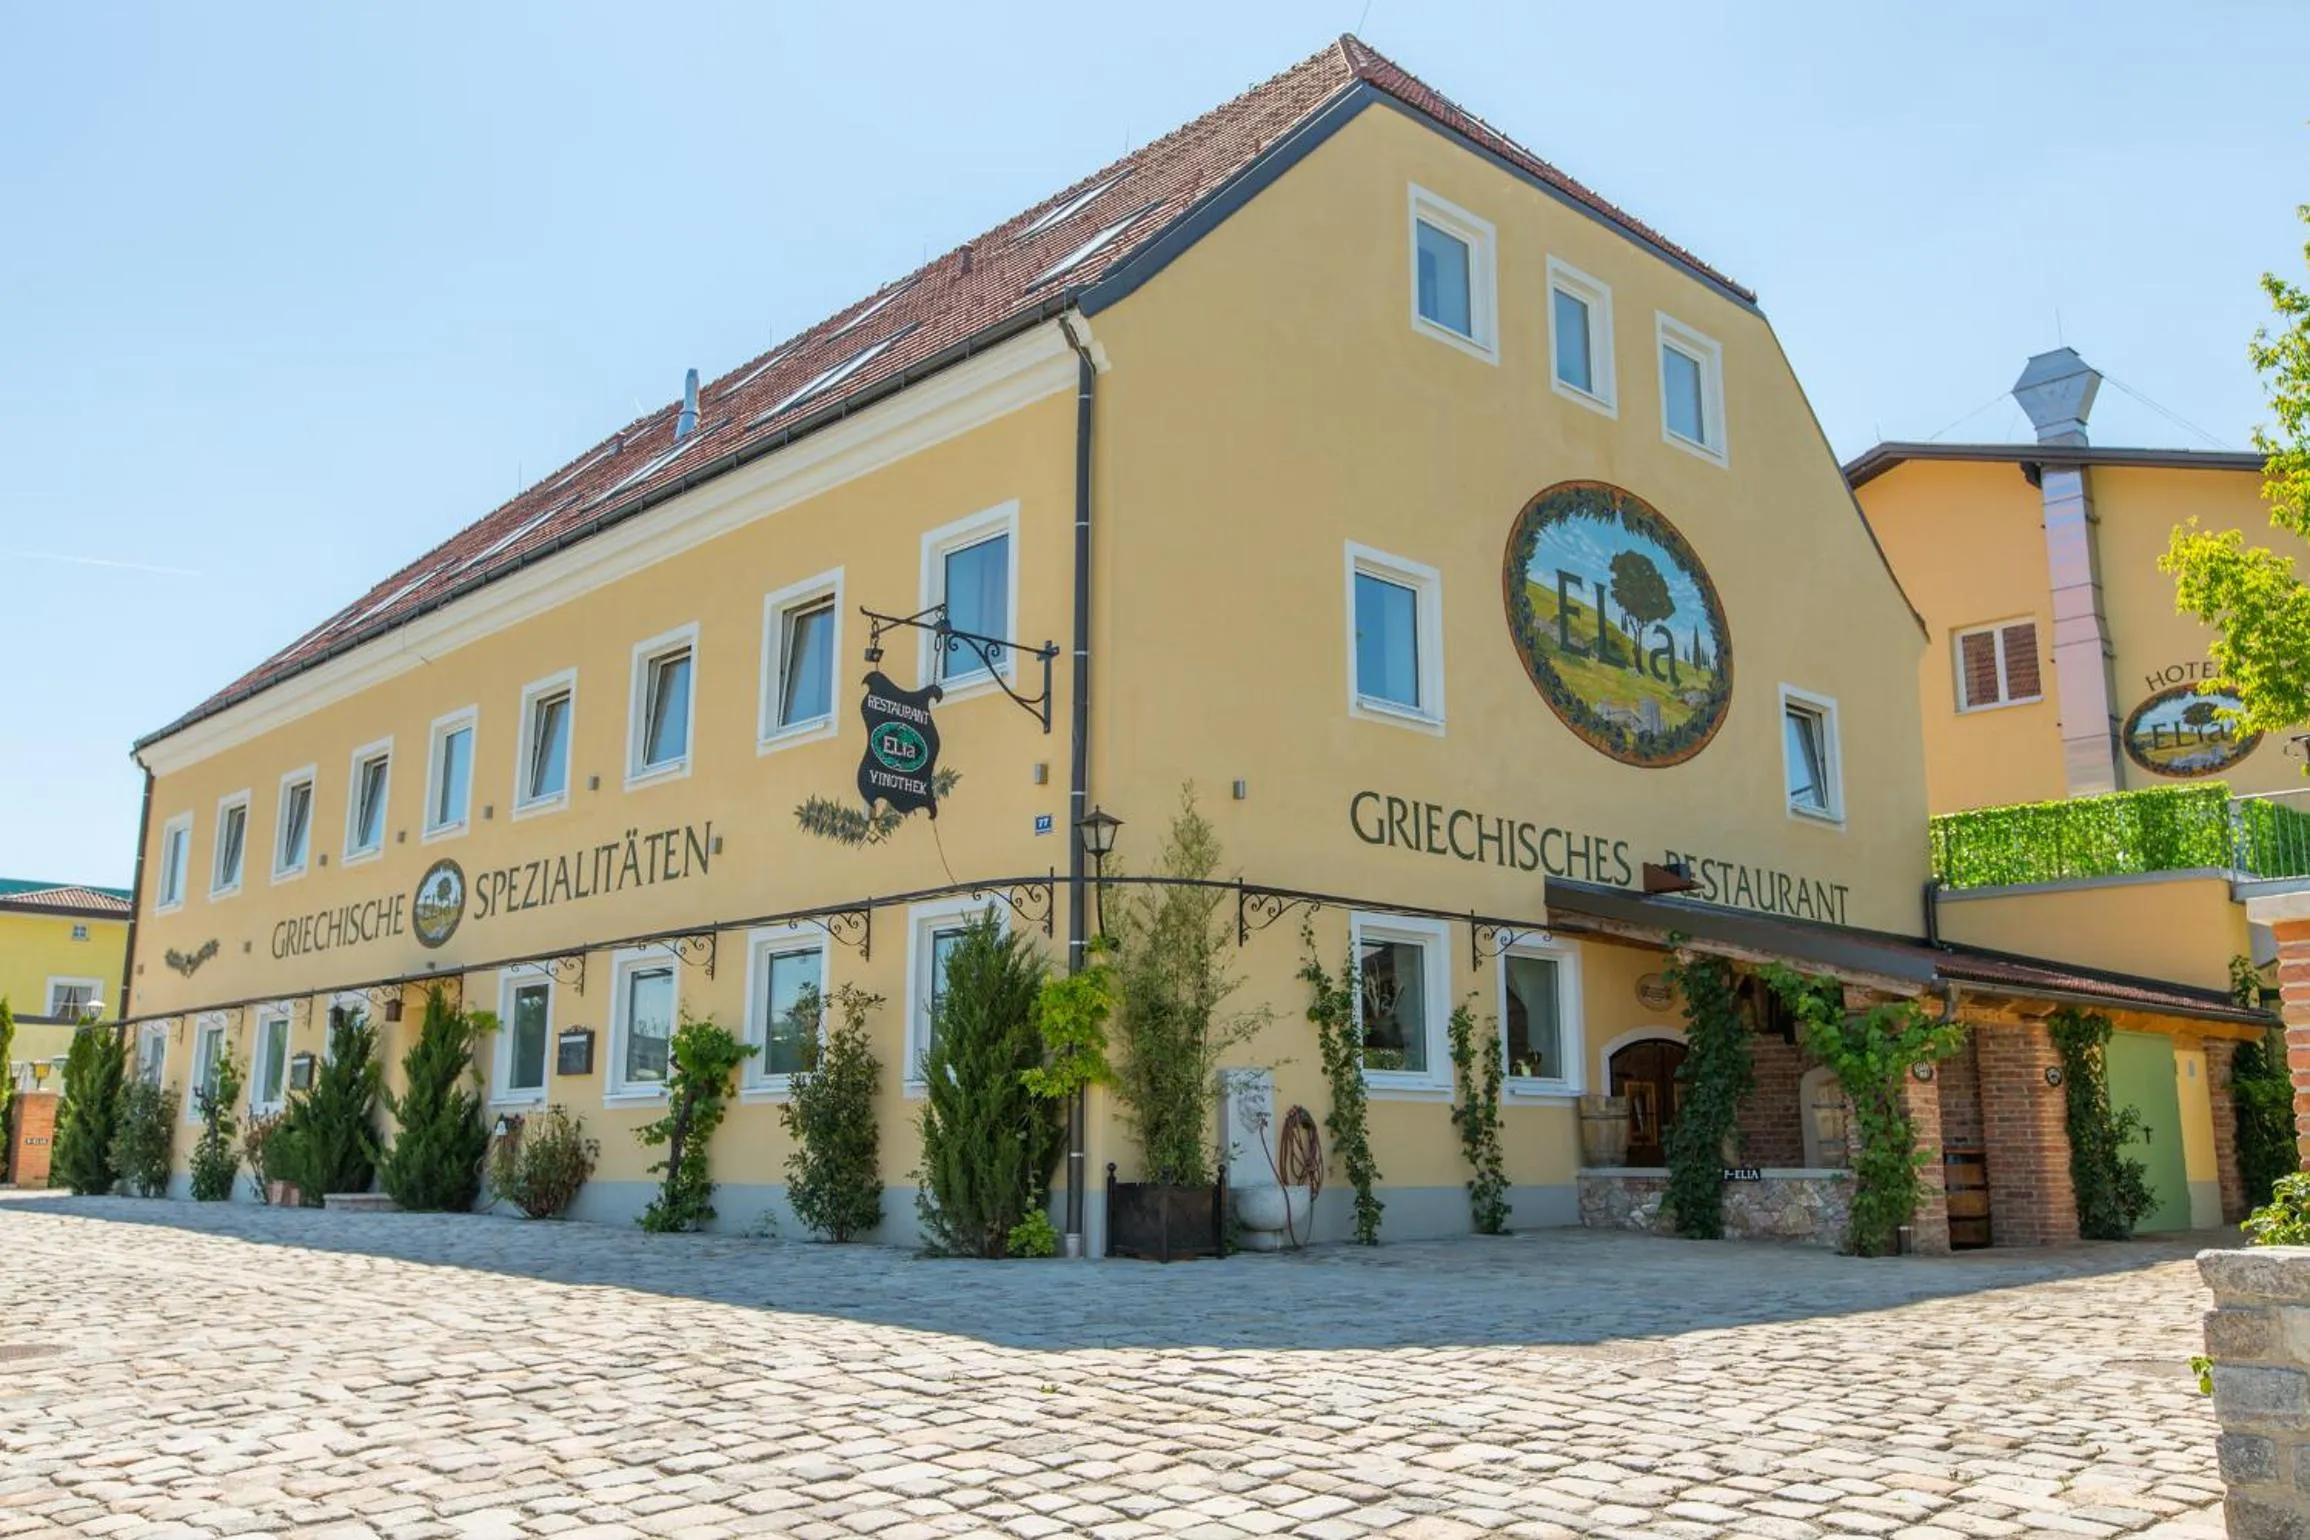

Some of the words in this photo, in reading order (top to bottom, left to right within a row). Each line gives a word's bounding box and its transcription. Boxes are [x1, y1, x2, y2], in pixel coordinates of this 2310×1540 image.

[2145, 660, 2221, 691] HOTE
[867, 694, 929, 725] RESTAURANT
[869, 769, 927, 796] VINOTHEK
[1349, 790, 1633, 887] GRIECHISCHES
[272, 894, 406, 960] GRIECHISCHE
[474, 820, 712, 920] SPEZIALITÄTEN
